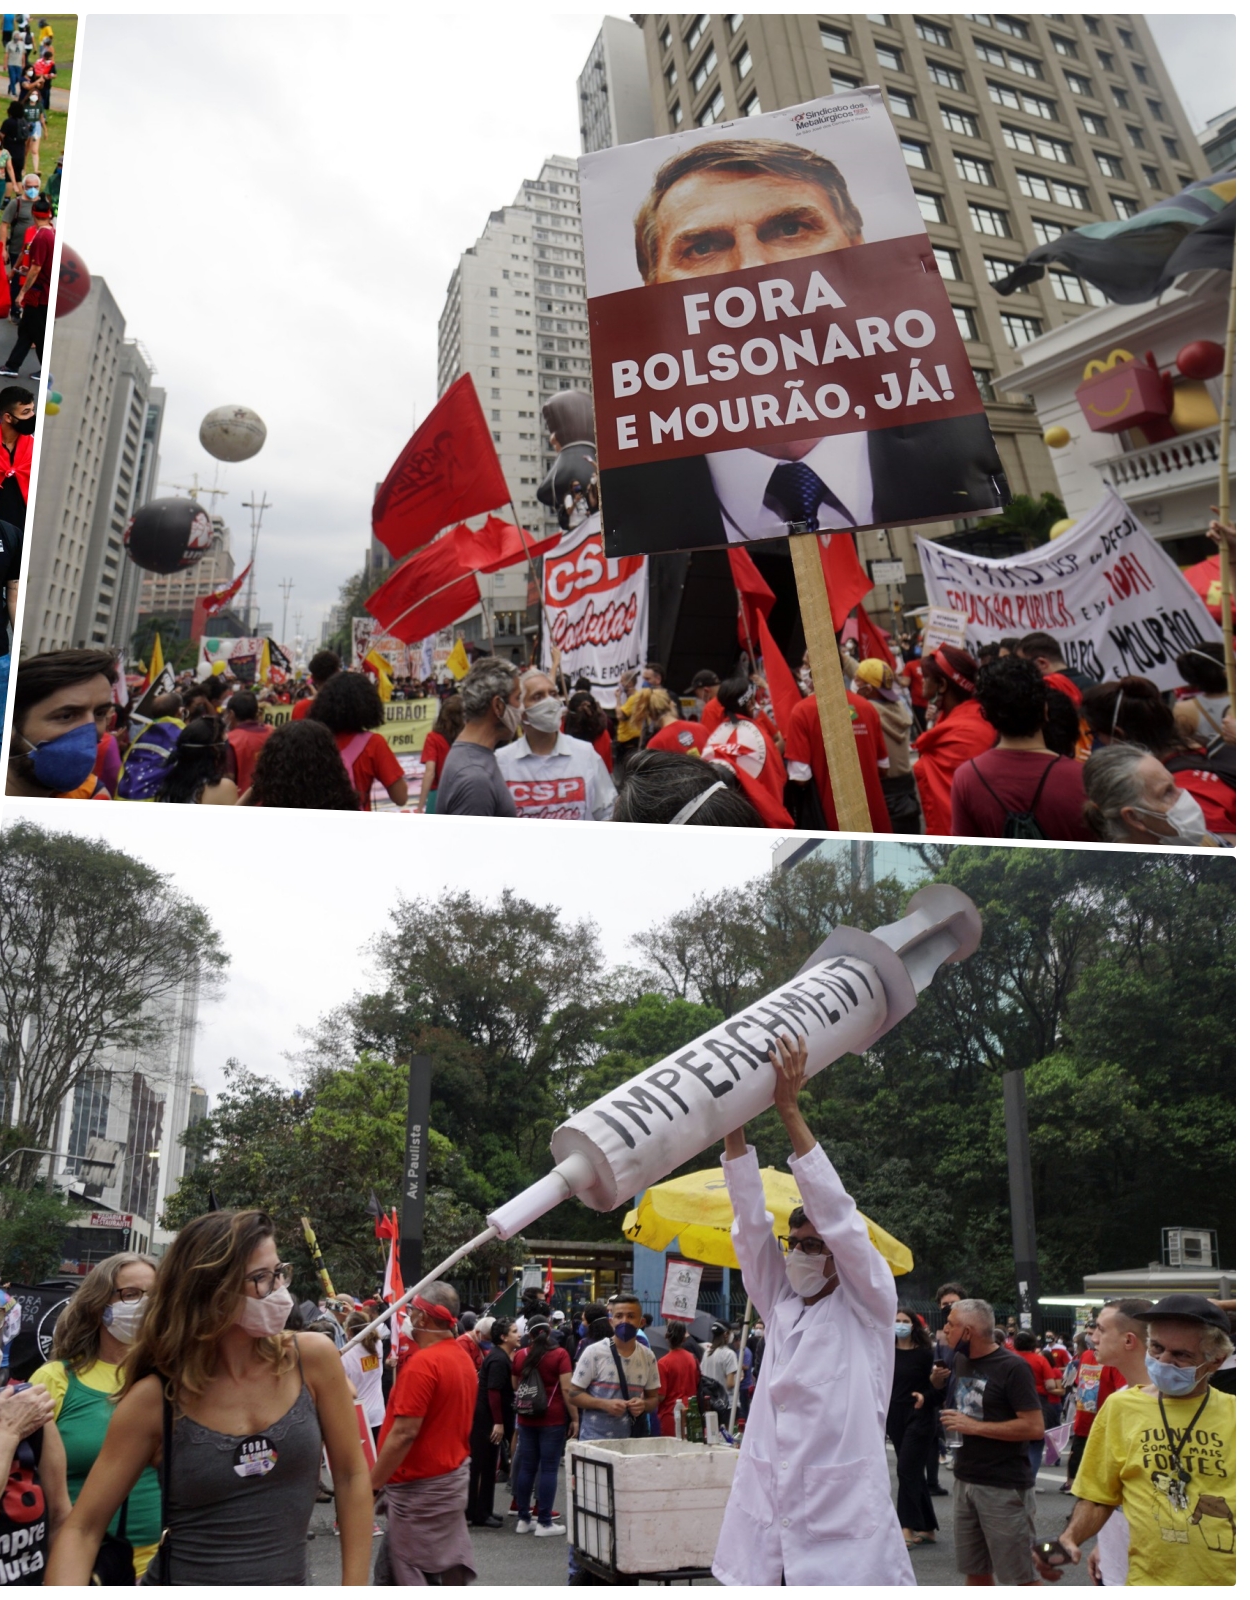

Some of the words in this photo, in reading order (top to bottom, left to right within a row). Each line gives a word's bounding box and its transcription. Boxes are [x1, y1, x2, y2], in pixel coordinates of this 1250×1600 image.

[795, 110, 855, 131] Metalúrgicos
[805, 104, 849, 120] Sindicato
[849, 102, 865, 110] dos
[682, 270, 847, 336] FORA
[611, 308, 937, 399] BOLSONARO
[615, 415, 639, 450] E
[649, 378, 866, 446] MOURÃO,
[874, 358, 956, 411] JÁ!
[1016, 588, 1076, 631] PÚBLICA
[550, 592, 638, 653] Conlutas
[384, 700, 428, 721] URÃO!
[391, 733, 415, 746] PSOL
[510, 780, 582, 799] CSP
[593, 956, 875, 1149] IMPEACHMENT
[407, 1124, 422, 1179] Paulista
[406, 1180, 418, 1200] Av.
[242, 1439, 268, 1455] FORA
[1140, 1427, 1225, 1448] JUNTOS
[1189, 1448, 1222, 1459] MAIS
